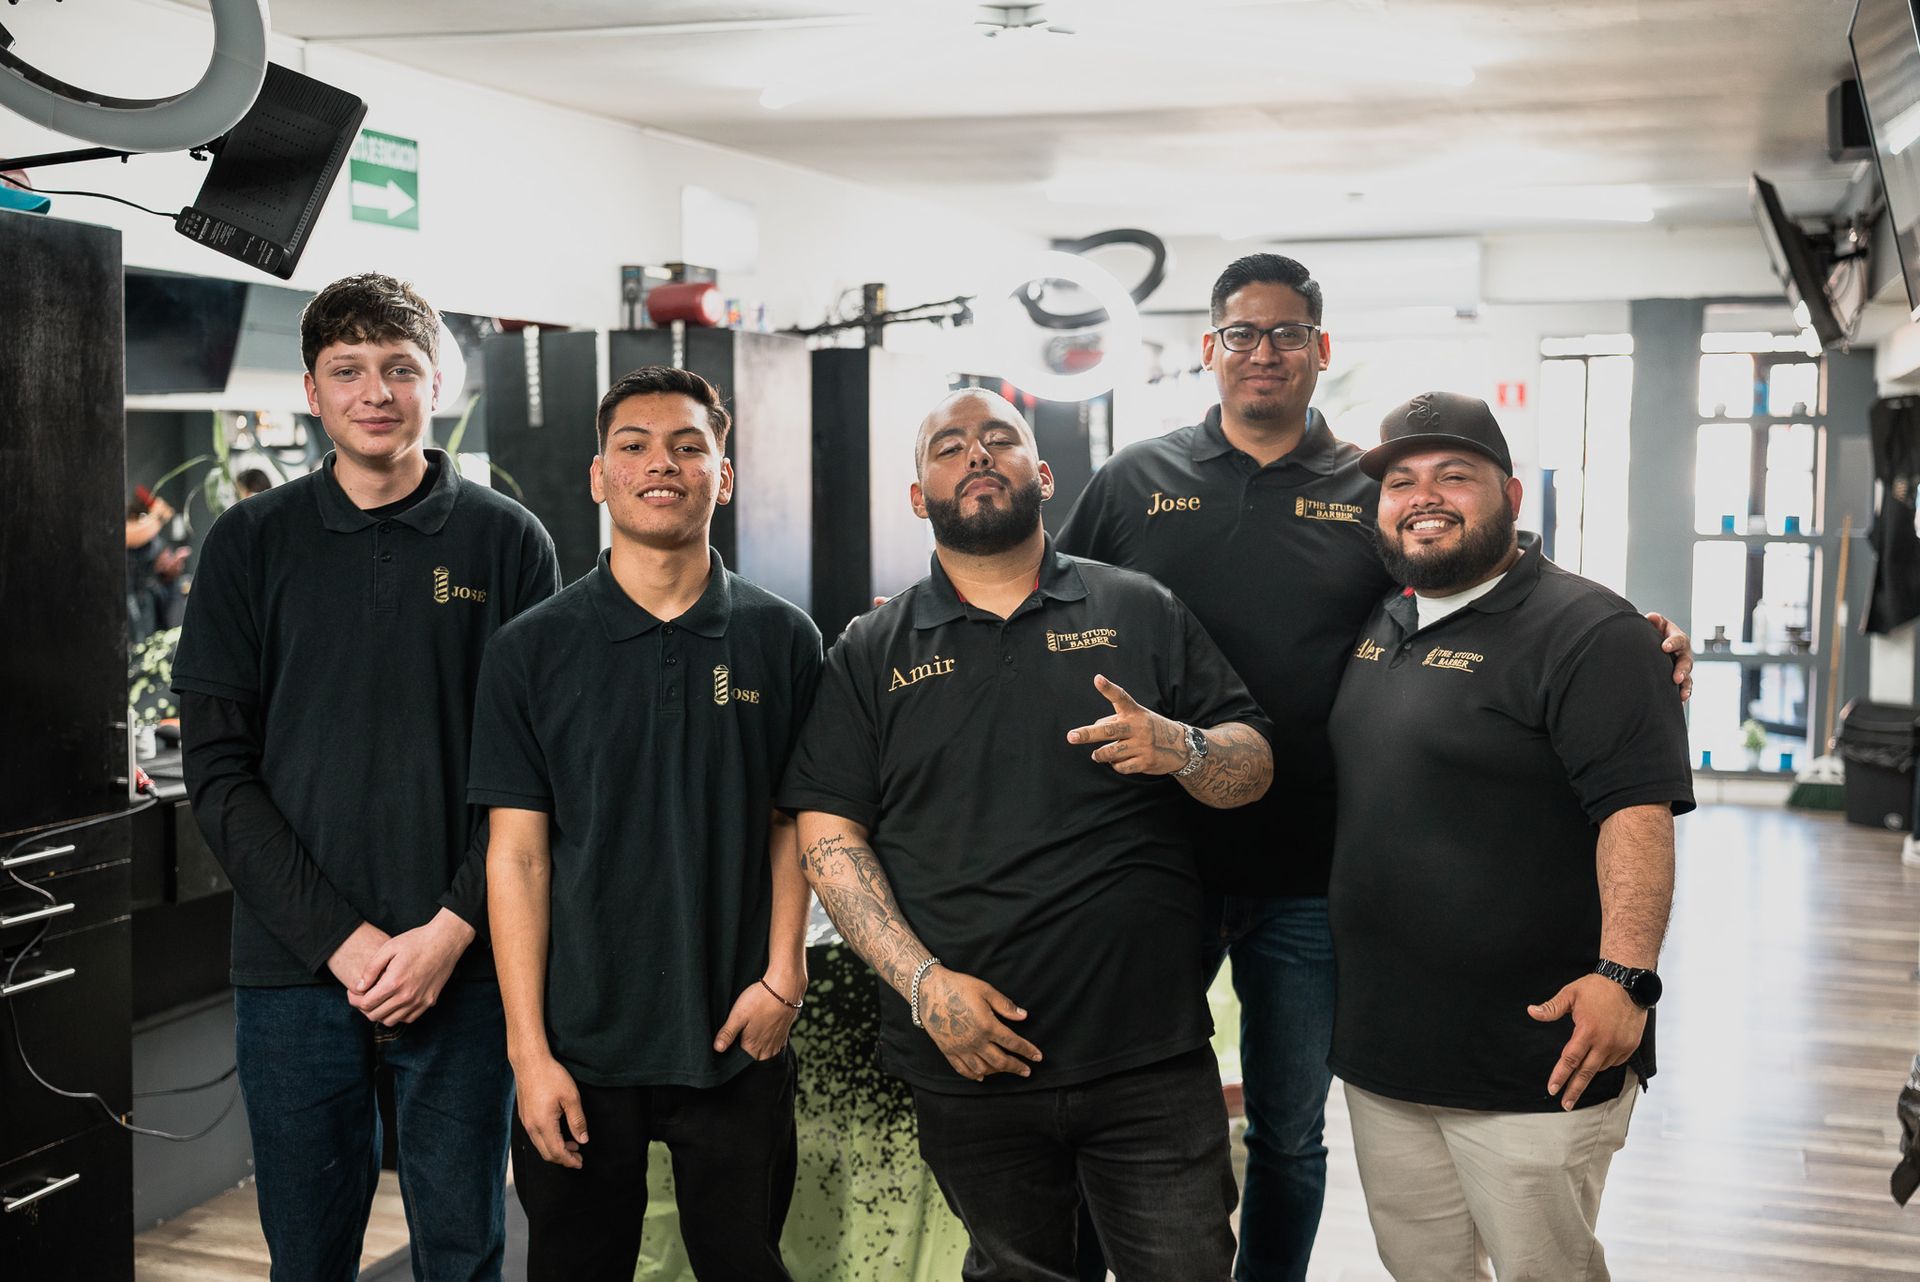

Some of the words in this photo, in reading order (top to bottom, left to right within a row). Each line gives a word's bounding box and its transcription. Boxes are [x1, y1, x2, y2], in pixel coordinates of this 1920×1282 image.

[1147, 492, 1201, 516] Jose
[1307, 500, 1326, 510] THE
[1329, 503, 1362, 514] STUDIO
[1316, 510, 1354, 520] BARBER
[1058, 633, 1079, 641] THE
[1081, 628, 1117, 639] STUDIO
[1070, 636, 1110, 648] BARBER
[1437, 657, 1469, 668] BARBER
[1438, 649, 1454, 658] THE
[1452, 651, 1484, 663] STUDIO
[888, 655, 955, 692] Amir
